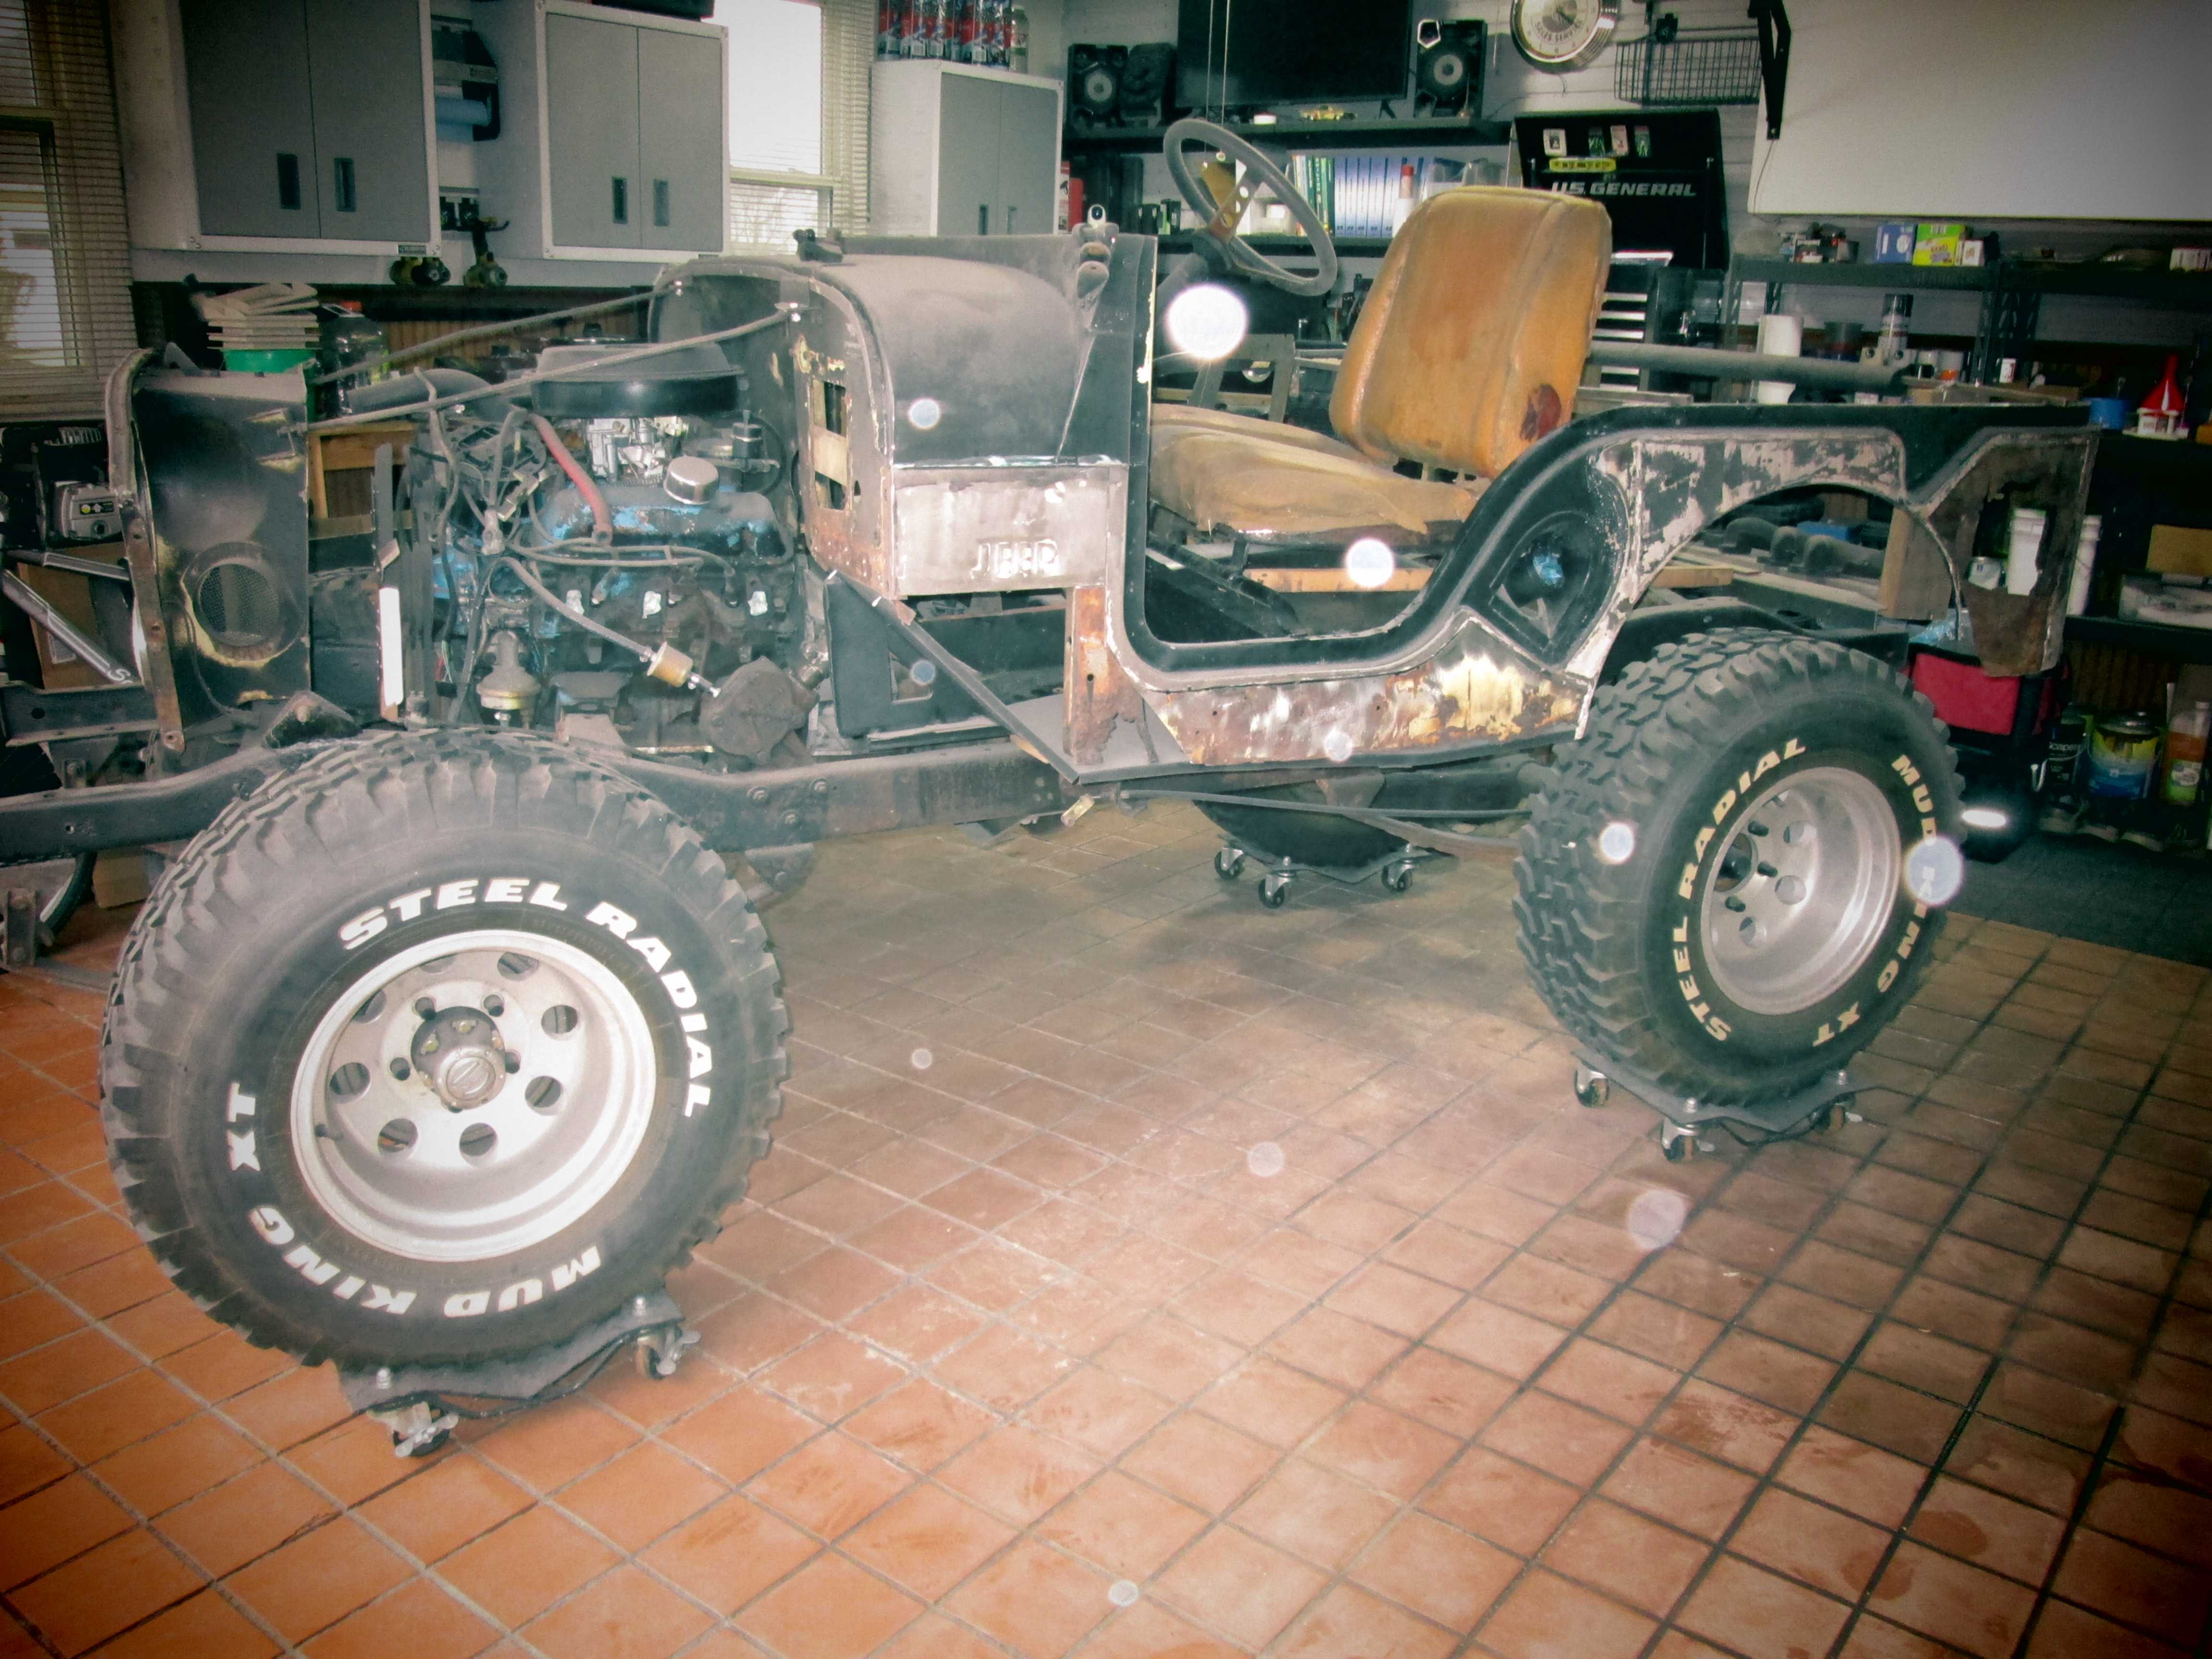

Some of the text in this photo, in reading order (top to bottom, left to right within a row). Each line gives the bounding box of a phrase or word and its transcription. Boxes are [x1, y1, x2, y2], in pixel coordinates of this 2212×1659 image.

[1589, 182, 1697, 196] GENERAL
[1891, 754, 1937, 846] MUD
[1673, 737, 1806, 1041] STEEL RADIAL
[338, 876, 712, 1118] STEEL RADIAL
[1812, 1001, 1861, 1047] XT
[226, 1082, 601, 1318] MUD KING XT
